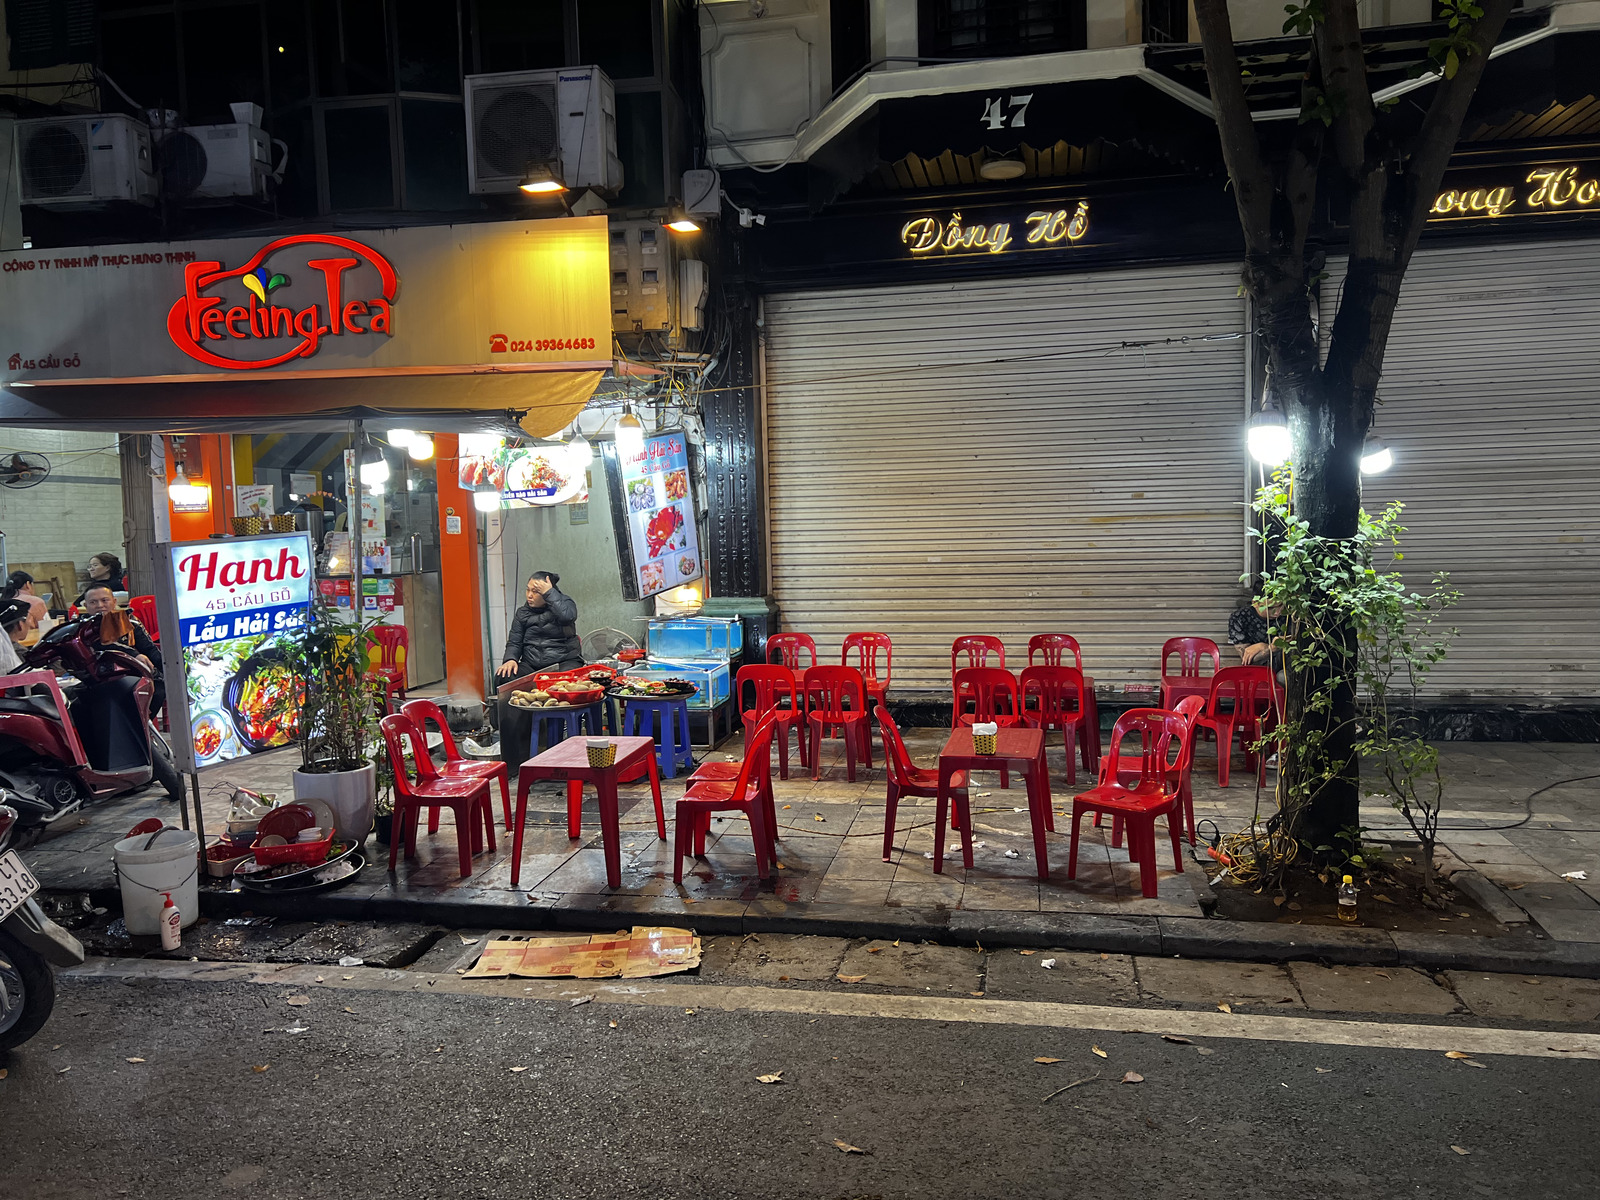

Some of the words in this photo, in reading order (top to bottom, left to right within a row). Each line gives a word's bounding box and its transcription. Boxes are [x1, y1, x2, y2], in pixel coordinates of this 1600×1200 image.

[559, 74, 592, 82] Panasonic
[979, 92, 1034, 131] 47
[1428, 186, 1517, 217] ong
[1525, 165, 1600, 206] Ho
[901, 211, 1013, 254] Đồng
[1024, 200, 1089, 243] Hồ
[38, 259, 51, 270] TY
[54, 257, 82, 269] TNHH
[83, 254, 99, 267] MỸ
[101, 253, 129, 268] THỰC
[131, 252, 163, 265] HƯNG
[164, 251, 197, 265] THỊNH
[184, 261, 328, 358] Feeling
[308, 258, 391, 335] Tea
[22, 359, 36, 370] 45
[38, 353, 60, 369] CẦU
[63, 352, 81, 368] GỖ
[510, 340, 533, 352] 024
[535, 337, 595, 351] 39364683
[178, 547, 306, 594] Hạnh
[205, 598, 226, 611] 45
[270, 586, 292, 603] GỖ
[188, 615, 228, 644] Lẩu
[233, 611, 270, 636] Hải
